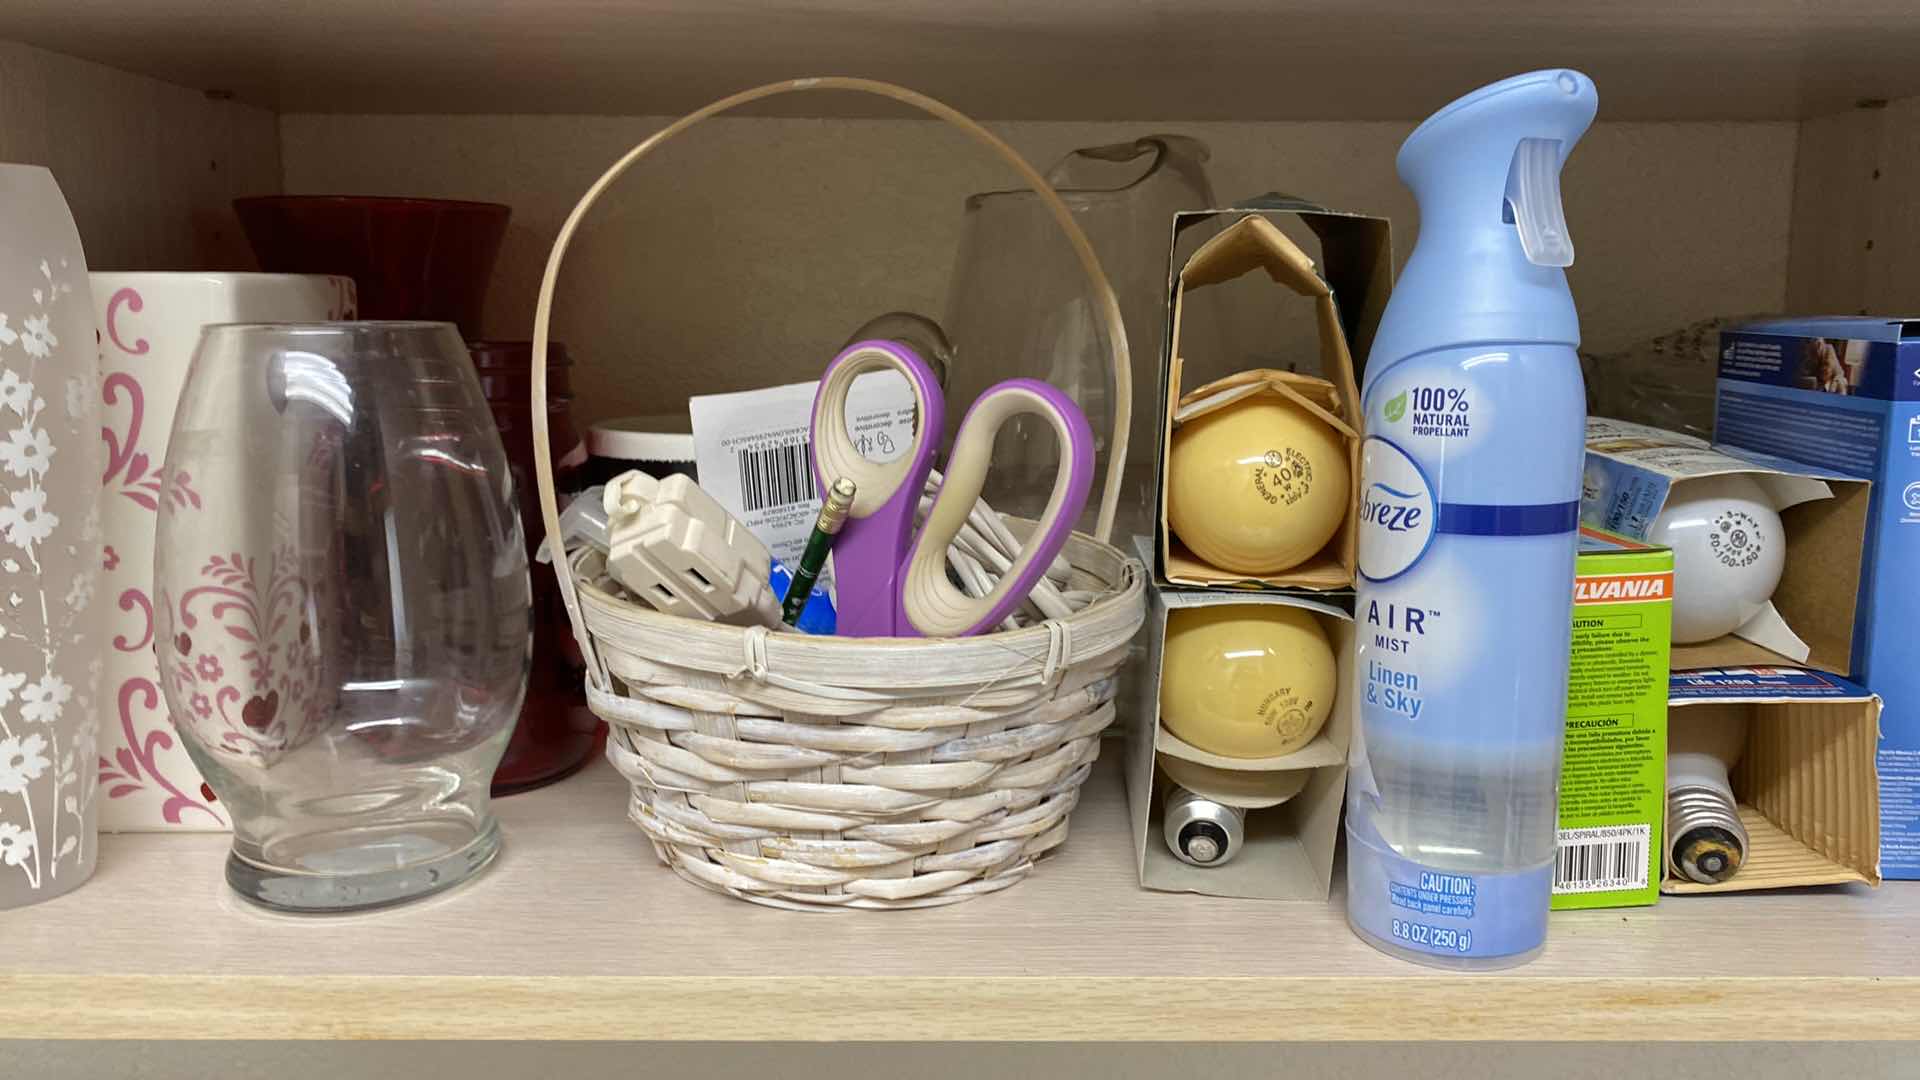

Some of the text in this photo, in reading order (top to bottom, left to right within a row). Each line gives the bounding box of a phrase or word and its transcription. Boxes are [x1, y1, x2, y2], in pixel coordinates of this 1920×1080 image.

[1412, 386, 1469, 412] 100%
[1413, 413, 1470, 427] NATURAL
[1412, 426, 1470, 437] PROPELLANT
[1254, 466, 1278, 505] GENERAL
[1273, 468, 1292, 487] 40
[1375, 634, 1409, 653] MIST
[1369, 659, 1418, 691] Linen
[1366, 682, 1421, 719] & Sky
[1421, 873, 1475, 895] CAUTION:
[1559, 880, 1591, 890] 46135
[1596, 878, 1628, 888] 26340
[1393, 919, 1471, 951] 8.8 OZ (250 g)
